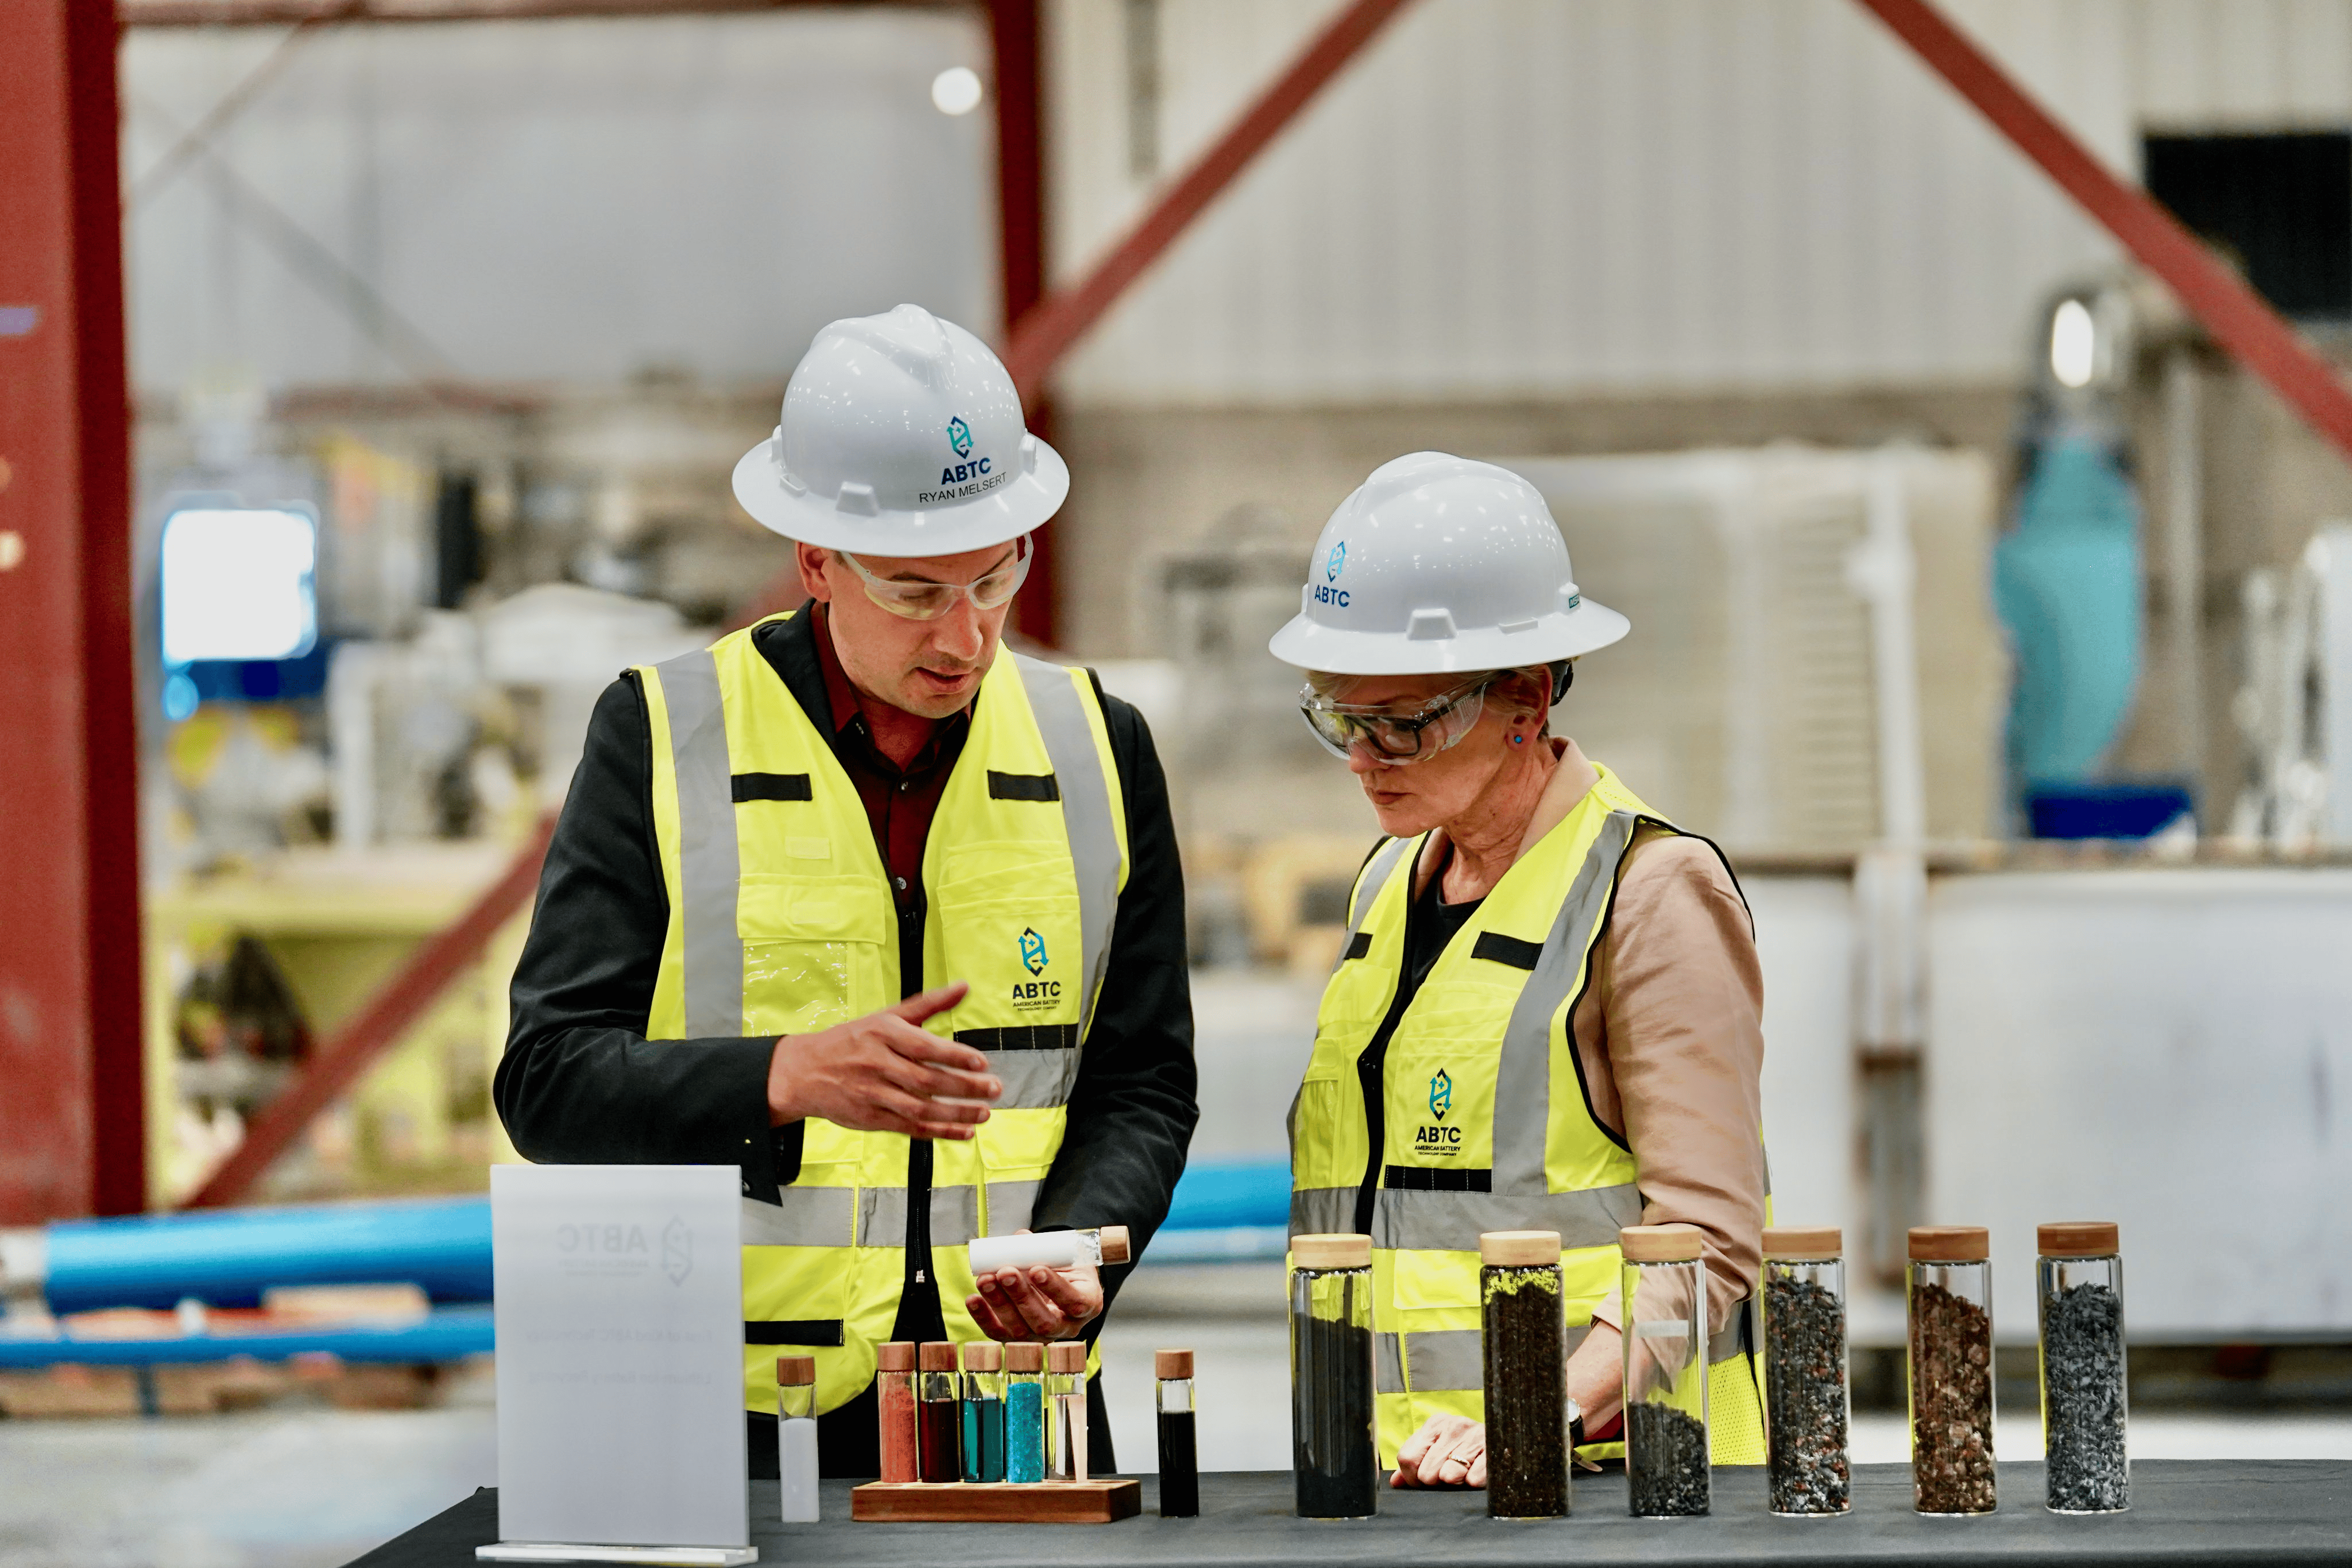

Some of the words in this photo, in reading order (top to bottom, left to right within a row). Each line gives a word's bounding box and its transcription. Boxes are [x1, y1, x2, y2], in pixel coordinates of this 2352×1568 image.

[941, 458, 992, 485] ABTC
[919, 489, 955, 503] RYAN
[959, 472, 1007, 497] MELSERT
[1314, 584, 1350, 607] ABTC
[1012, 981, 1061, 1000] ABTC
[1415, 1126, 1461, 1143] ABTC
